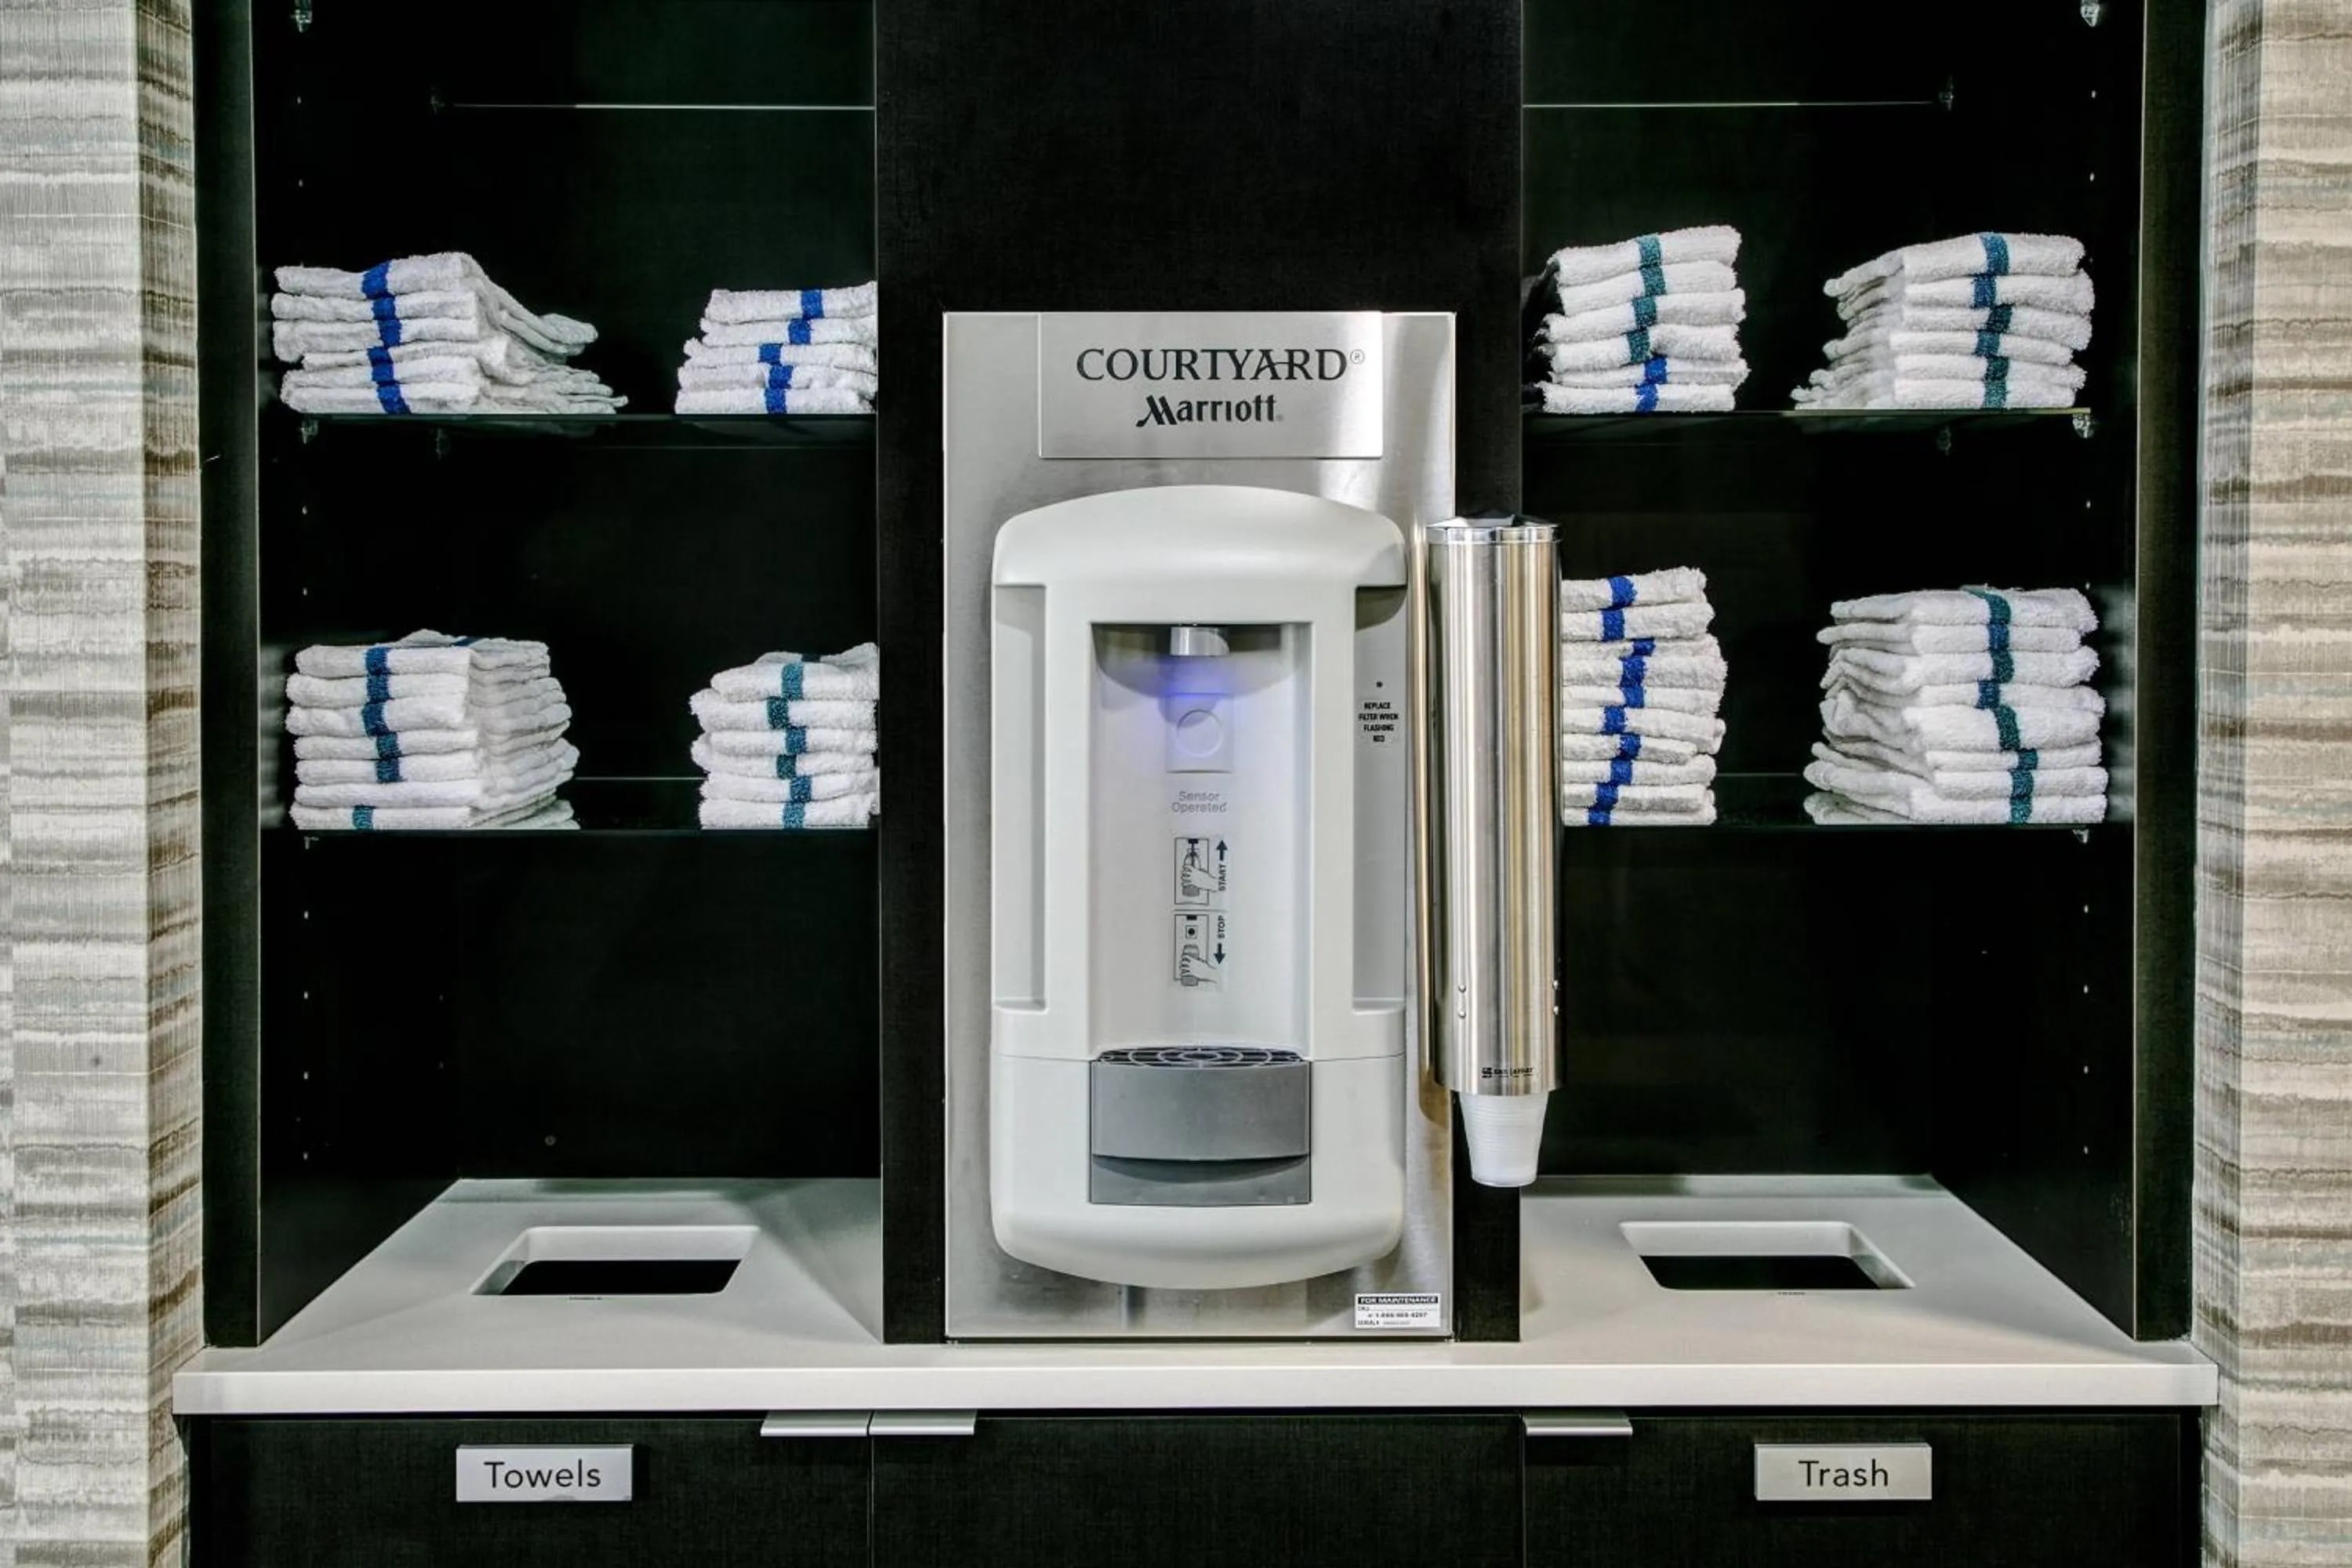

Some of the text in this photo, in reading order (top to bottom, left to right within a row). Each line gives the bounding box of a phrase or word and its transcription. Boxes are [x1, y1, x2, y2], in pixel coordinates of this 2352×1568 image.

[1136, 394, 1276, 427] Marriott
[1171, 802, 1227, 814] Operated
[1178, 790, 1221, 801] Sensor
[1218, 864, 1226, 891] START
[1217, 915, 1225, 939] STOP
[484, 1458, 601, 1489] Towels
[1798, 1458, 1889, 1487] Trash
